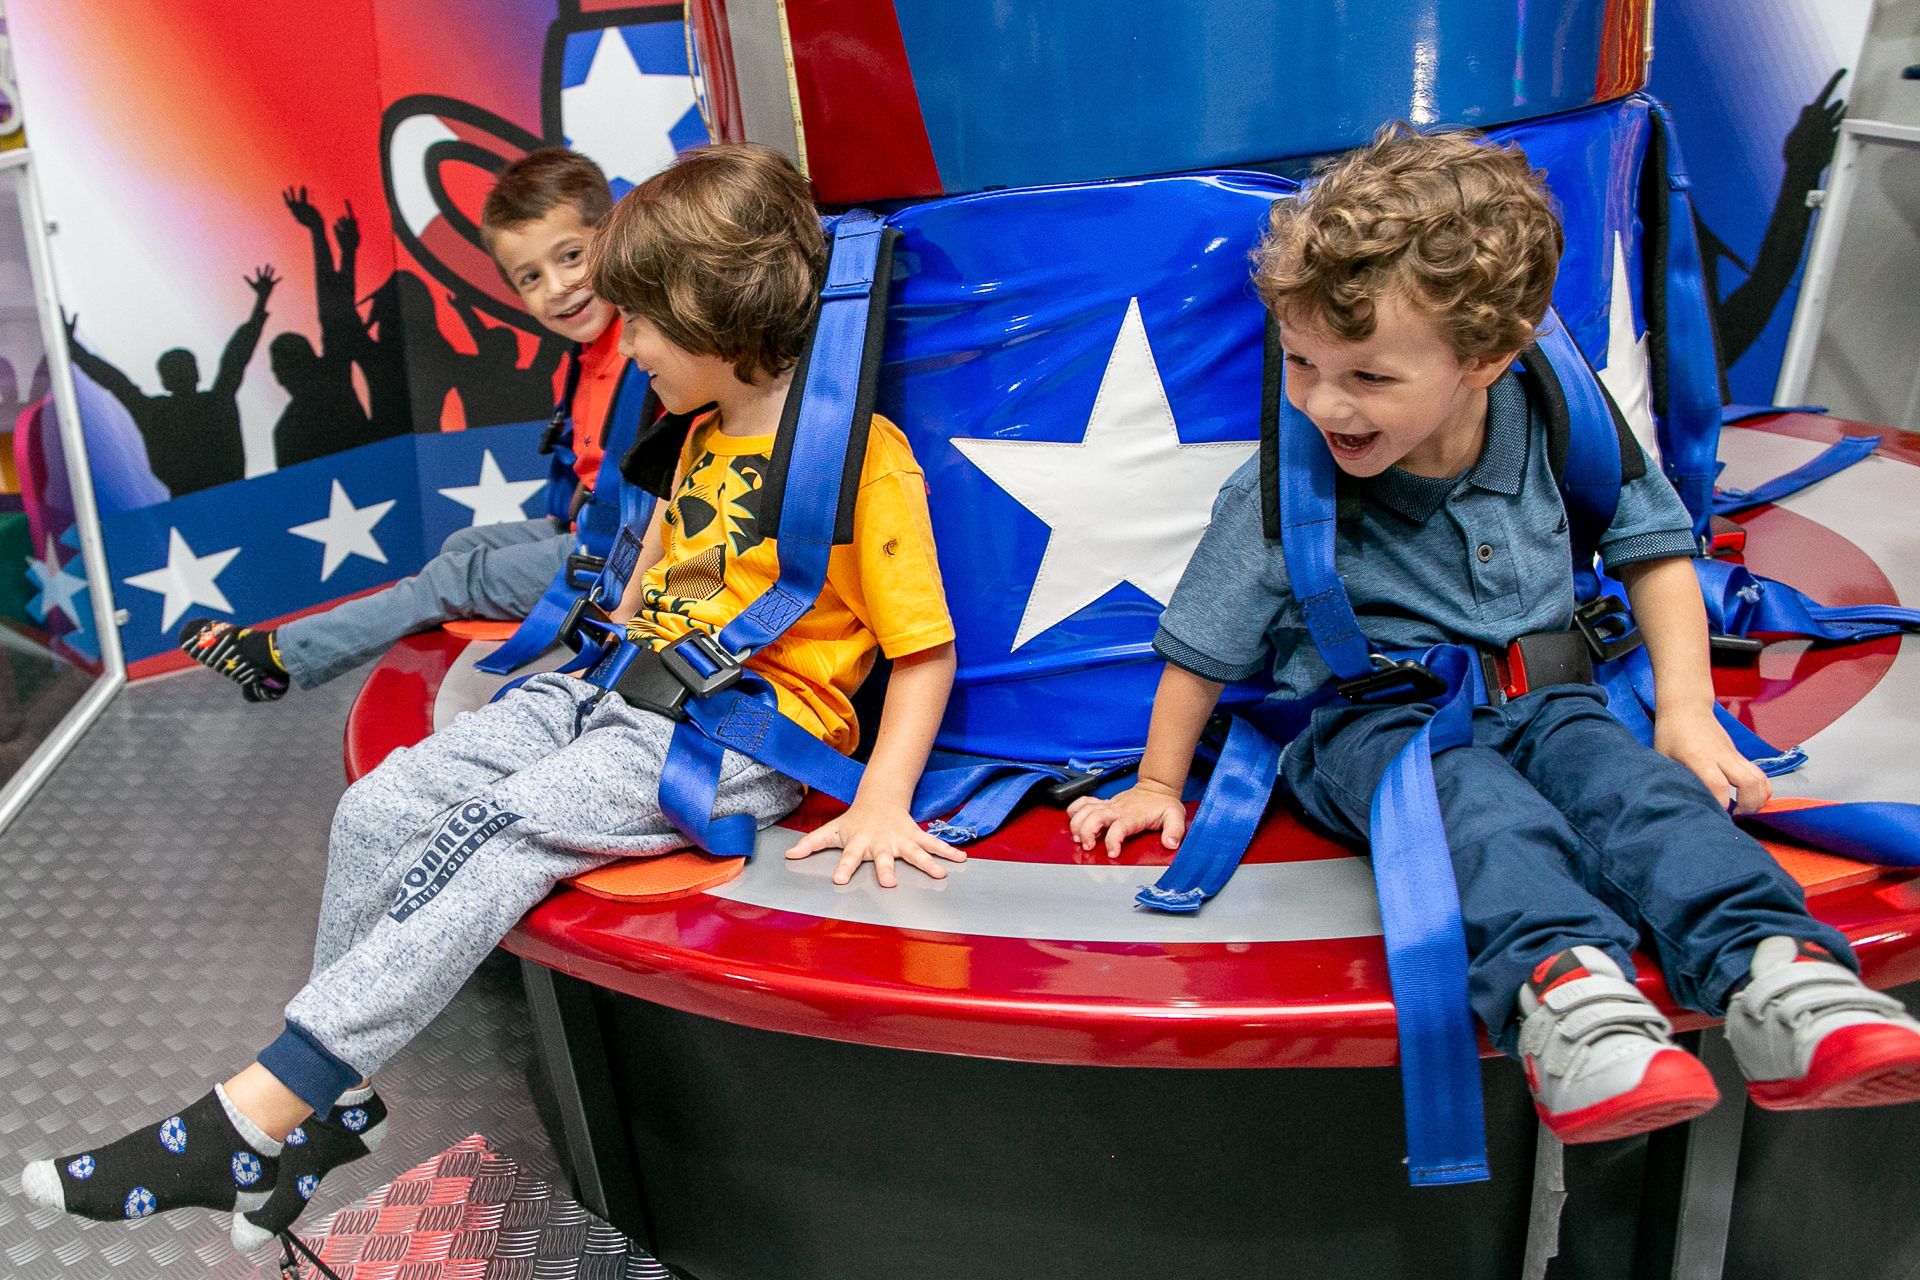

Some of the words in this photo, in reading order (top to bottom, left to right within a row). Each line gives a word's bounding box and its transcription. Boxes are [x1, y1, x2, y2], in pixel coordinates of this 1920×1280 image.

[394, 800, 501, 907] ONNEC
[408, 883, 440, 909] WITH
[440, 845, 473, 879] YOUR
[474, 815, 508, 844] MIND
